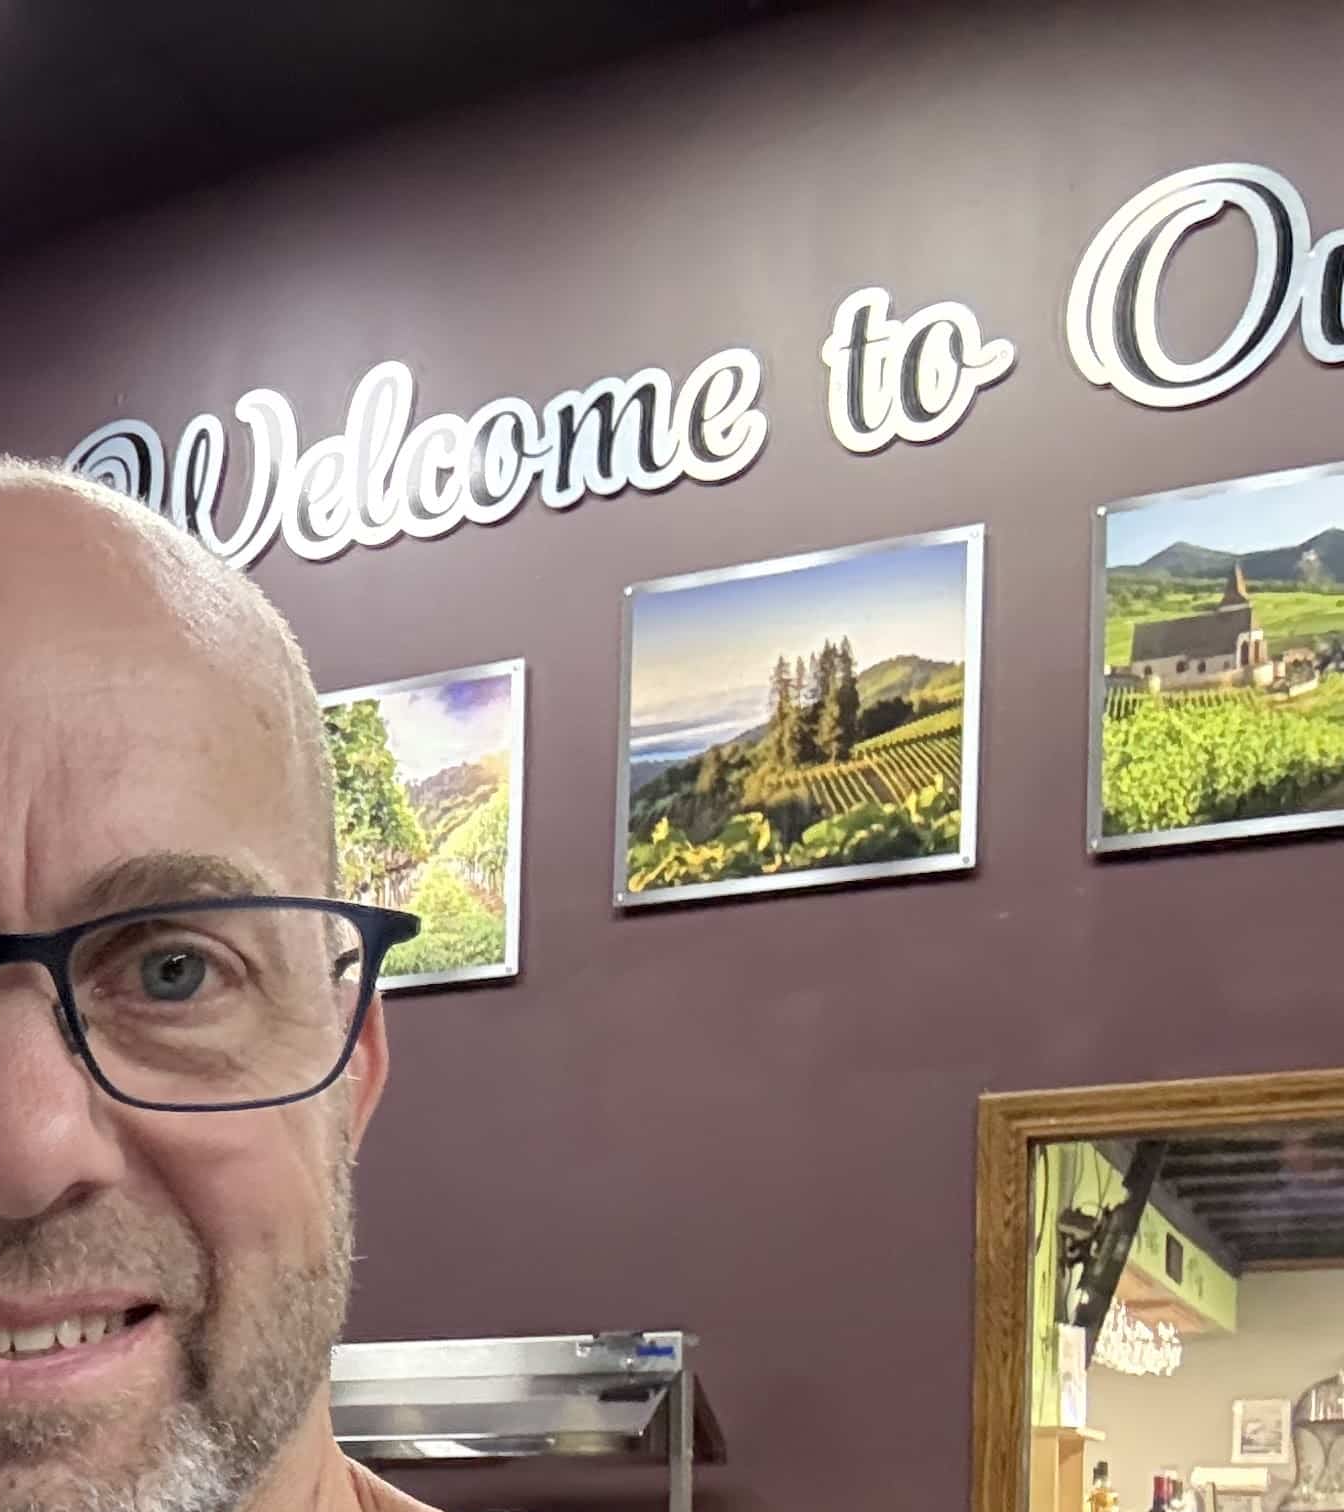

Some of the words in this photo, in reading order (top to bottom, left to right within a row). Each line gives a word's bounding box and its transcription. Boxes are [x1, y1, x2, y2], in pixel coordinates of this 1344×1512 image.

[66, 348, 769, 568] Welcome
[822, 287, 1015, 454] to
[1066, 162, 1344, 408] O
